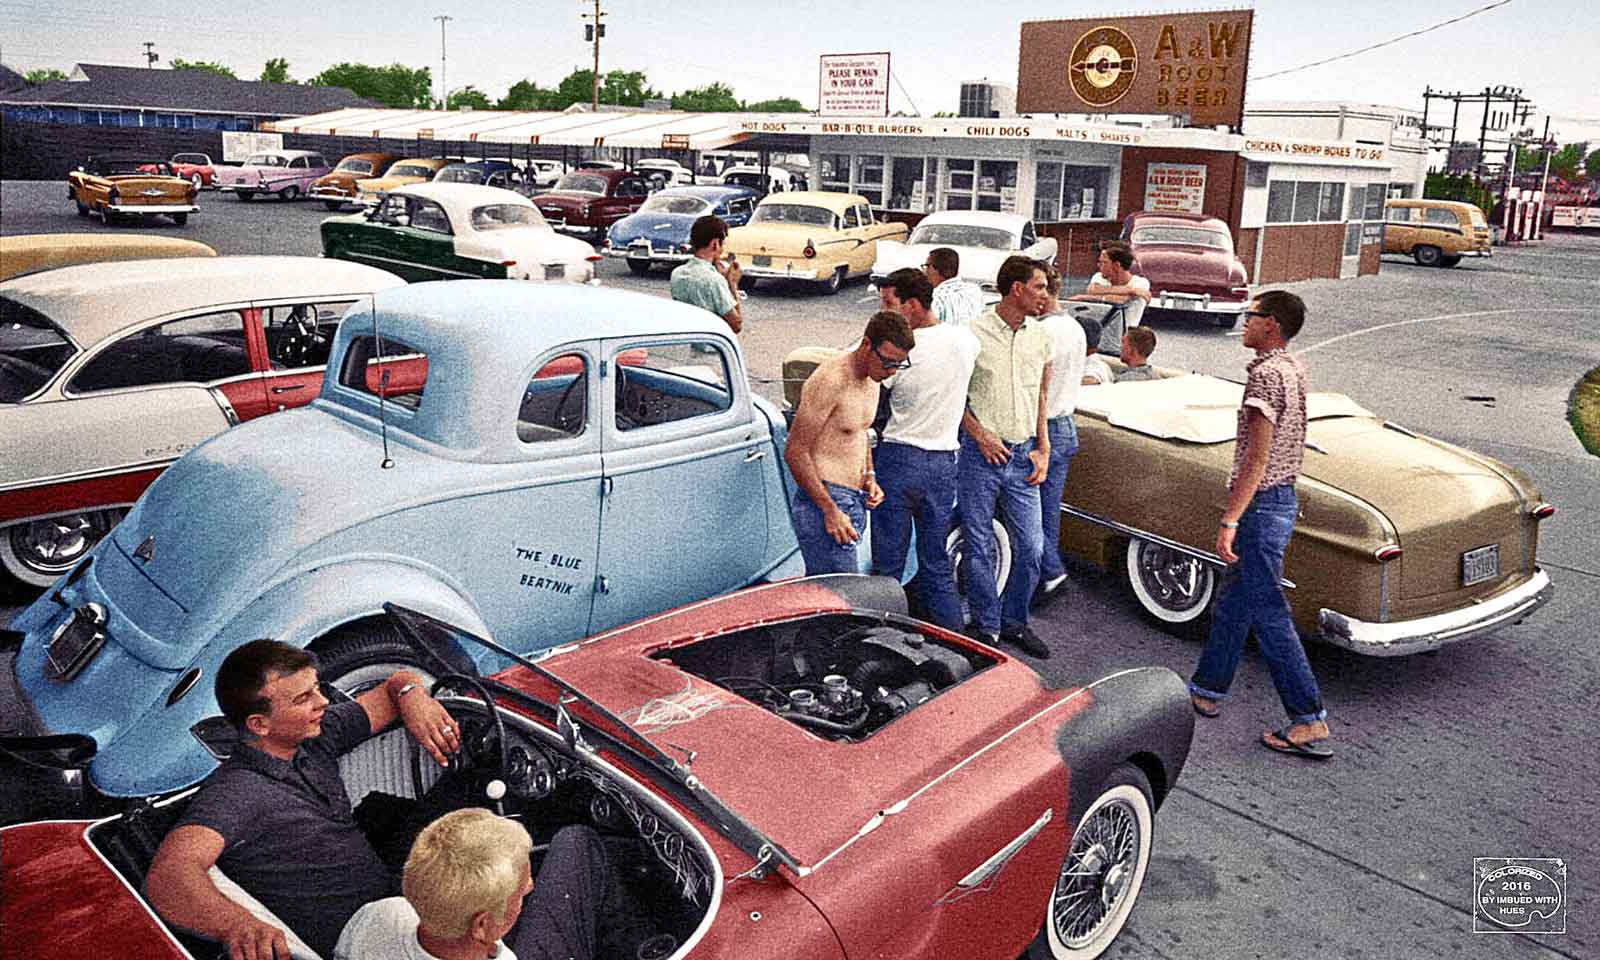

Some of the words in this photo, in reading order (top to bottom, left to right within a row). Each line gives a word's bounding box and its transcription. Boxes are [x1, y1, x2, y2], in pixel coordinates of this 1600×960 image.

[828, 69, 851, 78] PLEASE
[854, 68, 878, 77] REMAIN
[1159, 64, 1229, 82] ROOT
[831, 79, 838, 88] IN
[840, 79, 856, 88] YOUR
[859, 78, 874, 88] CAR
[1156, 86, 1229, 107] BEER
[741, 122, 758, 130] HOT
[763, 122, 787, 132] DOGS
[878, 124, 923, 134] BURGERS
[966, 126, 995, 137] CHILI
[999, 126, 1031, 138] DOGS
[1056, 129, 1089, 140] MALTS
[1245, 140, 1282, 152] CHICKEN
[1291, 143, 1322, 154] SHRIMP
[1324, 145, 1350, 158] BOXES
[1354, 147, 1367, 159] TO
[1368, 148, 1383, 160] GO
[516, 547, 543, 562] THE
[550, 553, 582, 570] BLUE
[519, 573, 574, 595] BEATNIK
